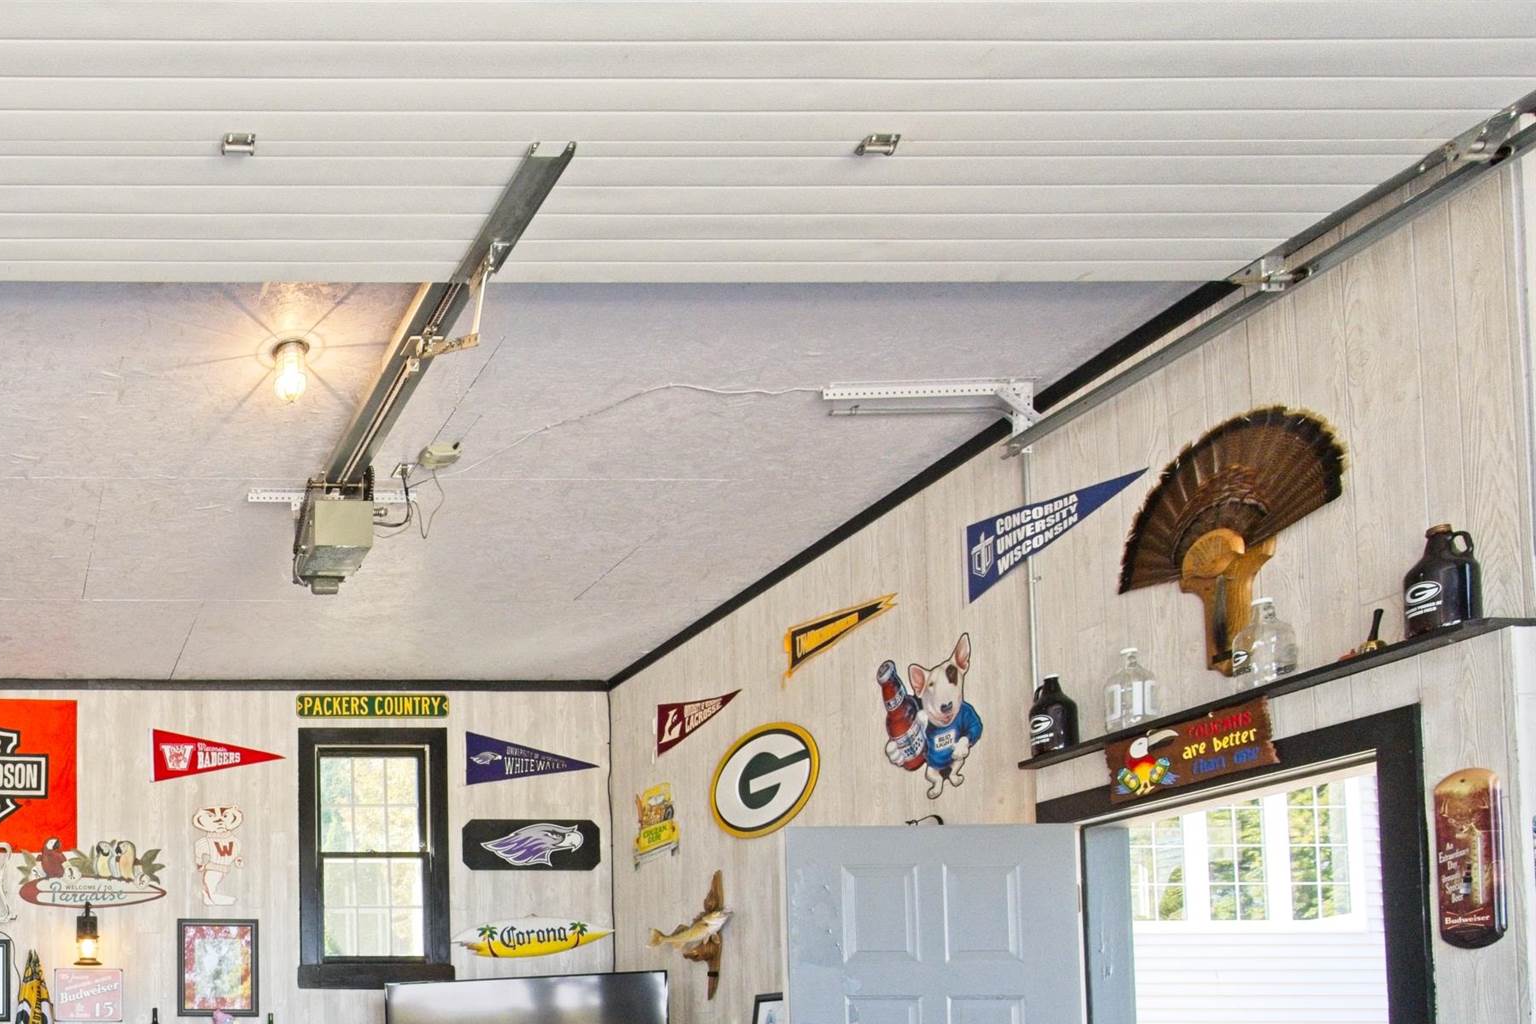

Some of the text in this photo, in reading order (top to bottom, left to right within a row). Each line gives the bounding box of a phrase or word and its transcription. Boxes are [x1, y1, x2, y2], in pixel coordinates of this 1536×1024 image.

[996, 493, 1078, 535] CONCORDIA
[996, 503, 1078, 555] UNIVERSITY
[997, 512, 1078, 576] WISCONSIN
[304, 697, 440, 715] PACKERS COUNTRY
[1183, 728, 1256, 759] are better
[197, 751, 241, 769] BADGERS
[504, 756, 567, 775] WHITEWATER
[49, 881, 128, 903] Paradise
[1444, 914, 1491, 925] Budweiser
[500, 925, 568, 950] Corona
[60, 982, 119, 1004] Budweiser
[95, 1001, 114, 1017] 15
